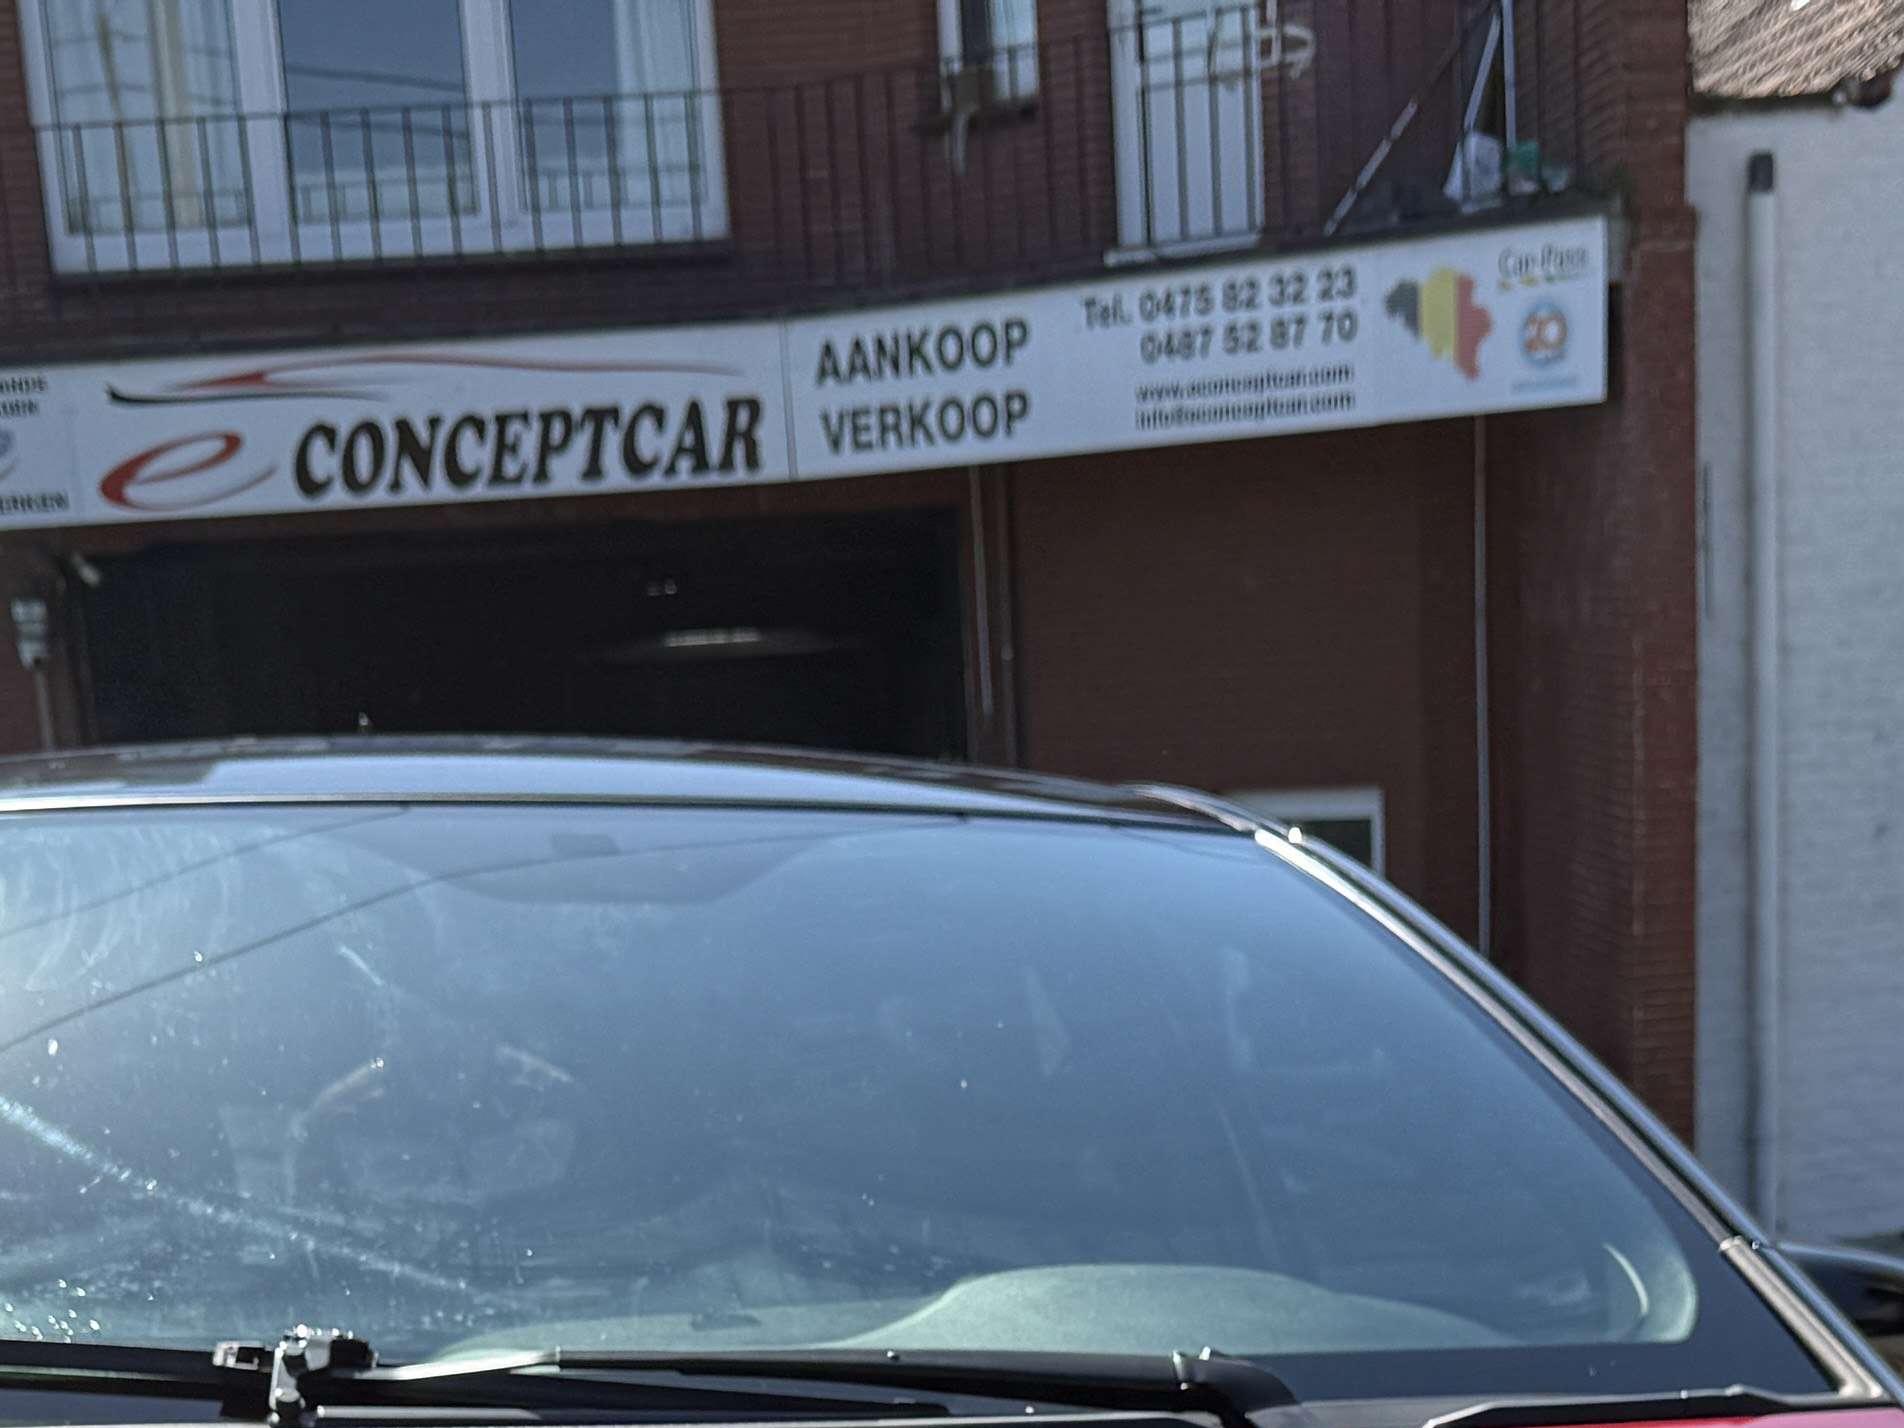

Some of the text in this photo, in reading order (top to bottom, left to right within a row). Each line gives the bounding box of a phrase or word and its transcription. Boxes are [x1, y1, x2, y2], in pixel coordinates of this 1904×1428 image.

[1082, 264, 1356, 330] Tel. 0475 82 32 23
[1317, 307, 1358, 345] 70
[816, 319, 1029, 387] AANKOOP
[821, 391, 1031, 457] VERKOOP
